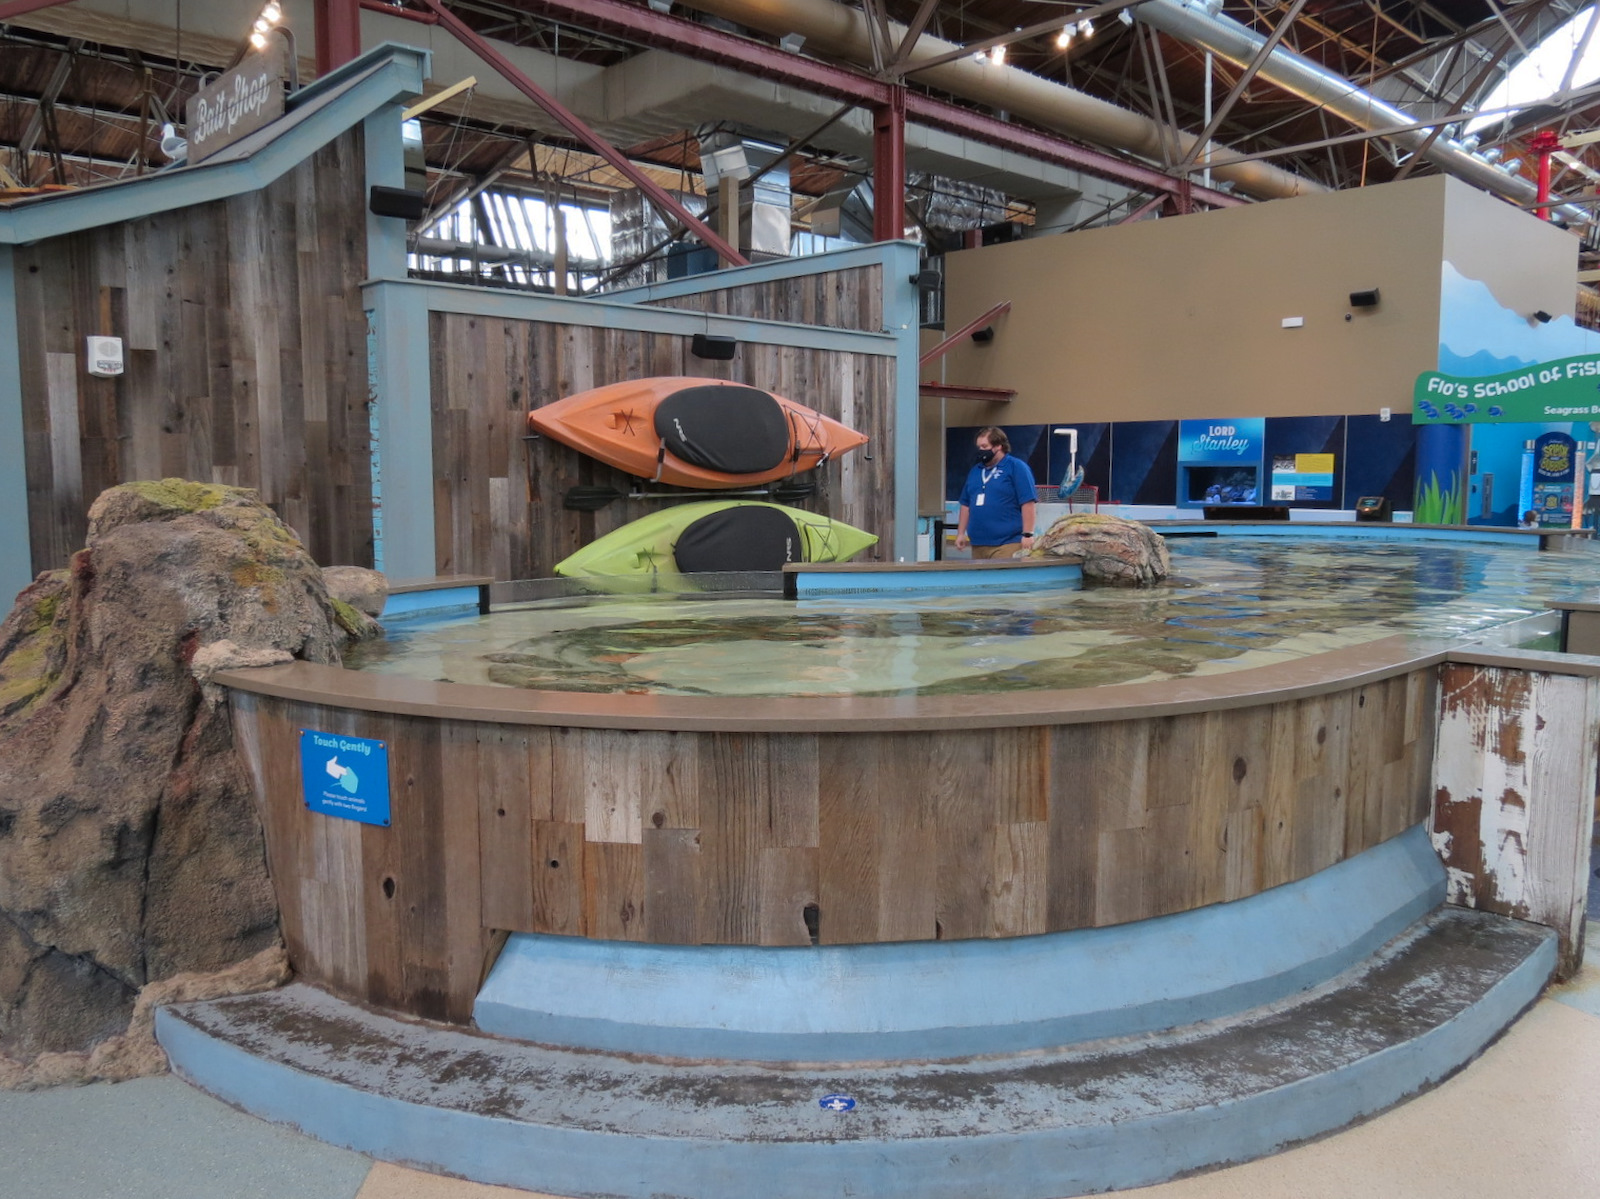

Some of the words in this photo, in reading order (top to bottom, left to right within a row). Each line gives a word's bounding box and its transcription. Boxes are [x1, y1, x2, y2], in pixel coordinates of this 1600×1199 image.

[194, 90, 226, 144] Bait
[227, 73, 270, 134] Shop
[1428, 377, 1469, 399] Flo's
[1544, 405, 1589, 417] Seagrass
[1209, 425, 1235, 437] LORD
[1192, 434, 1249, 455] Stanley
[313, 735, 338, 749] Touch
[339, 740, 371, 756] Gently
